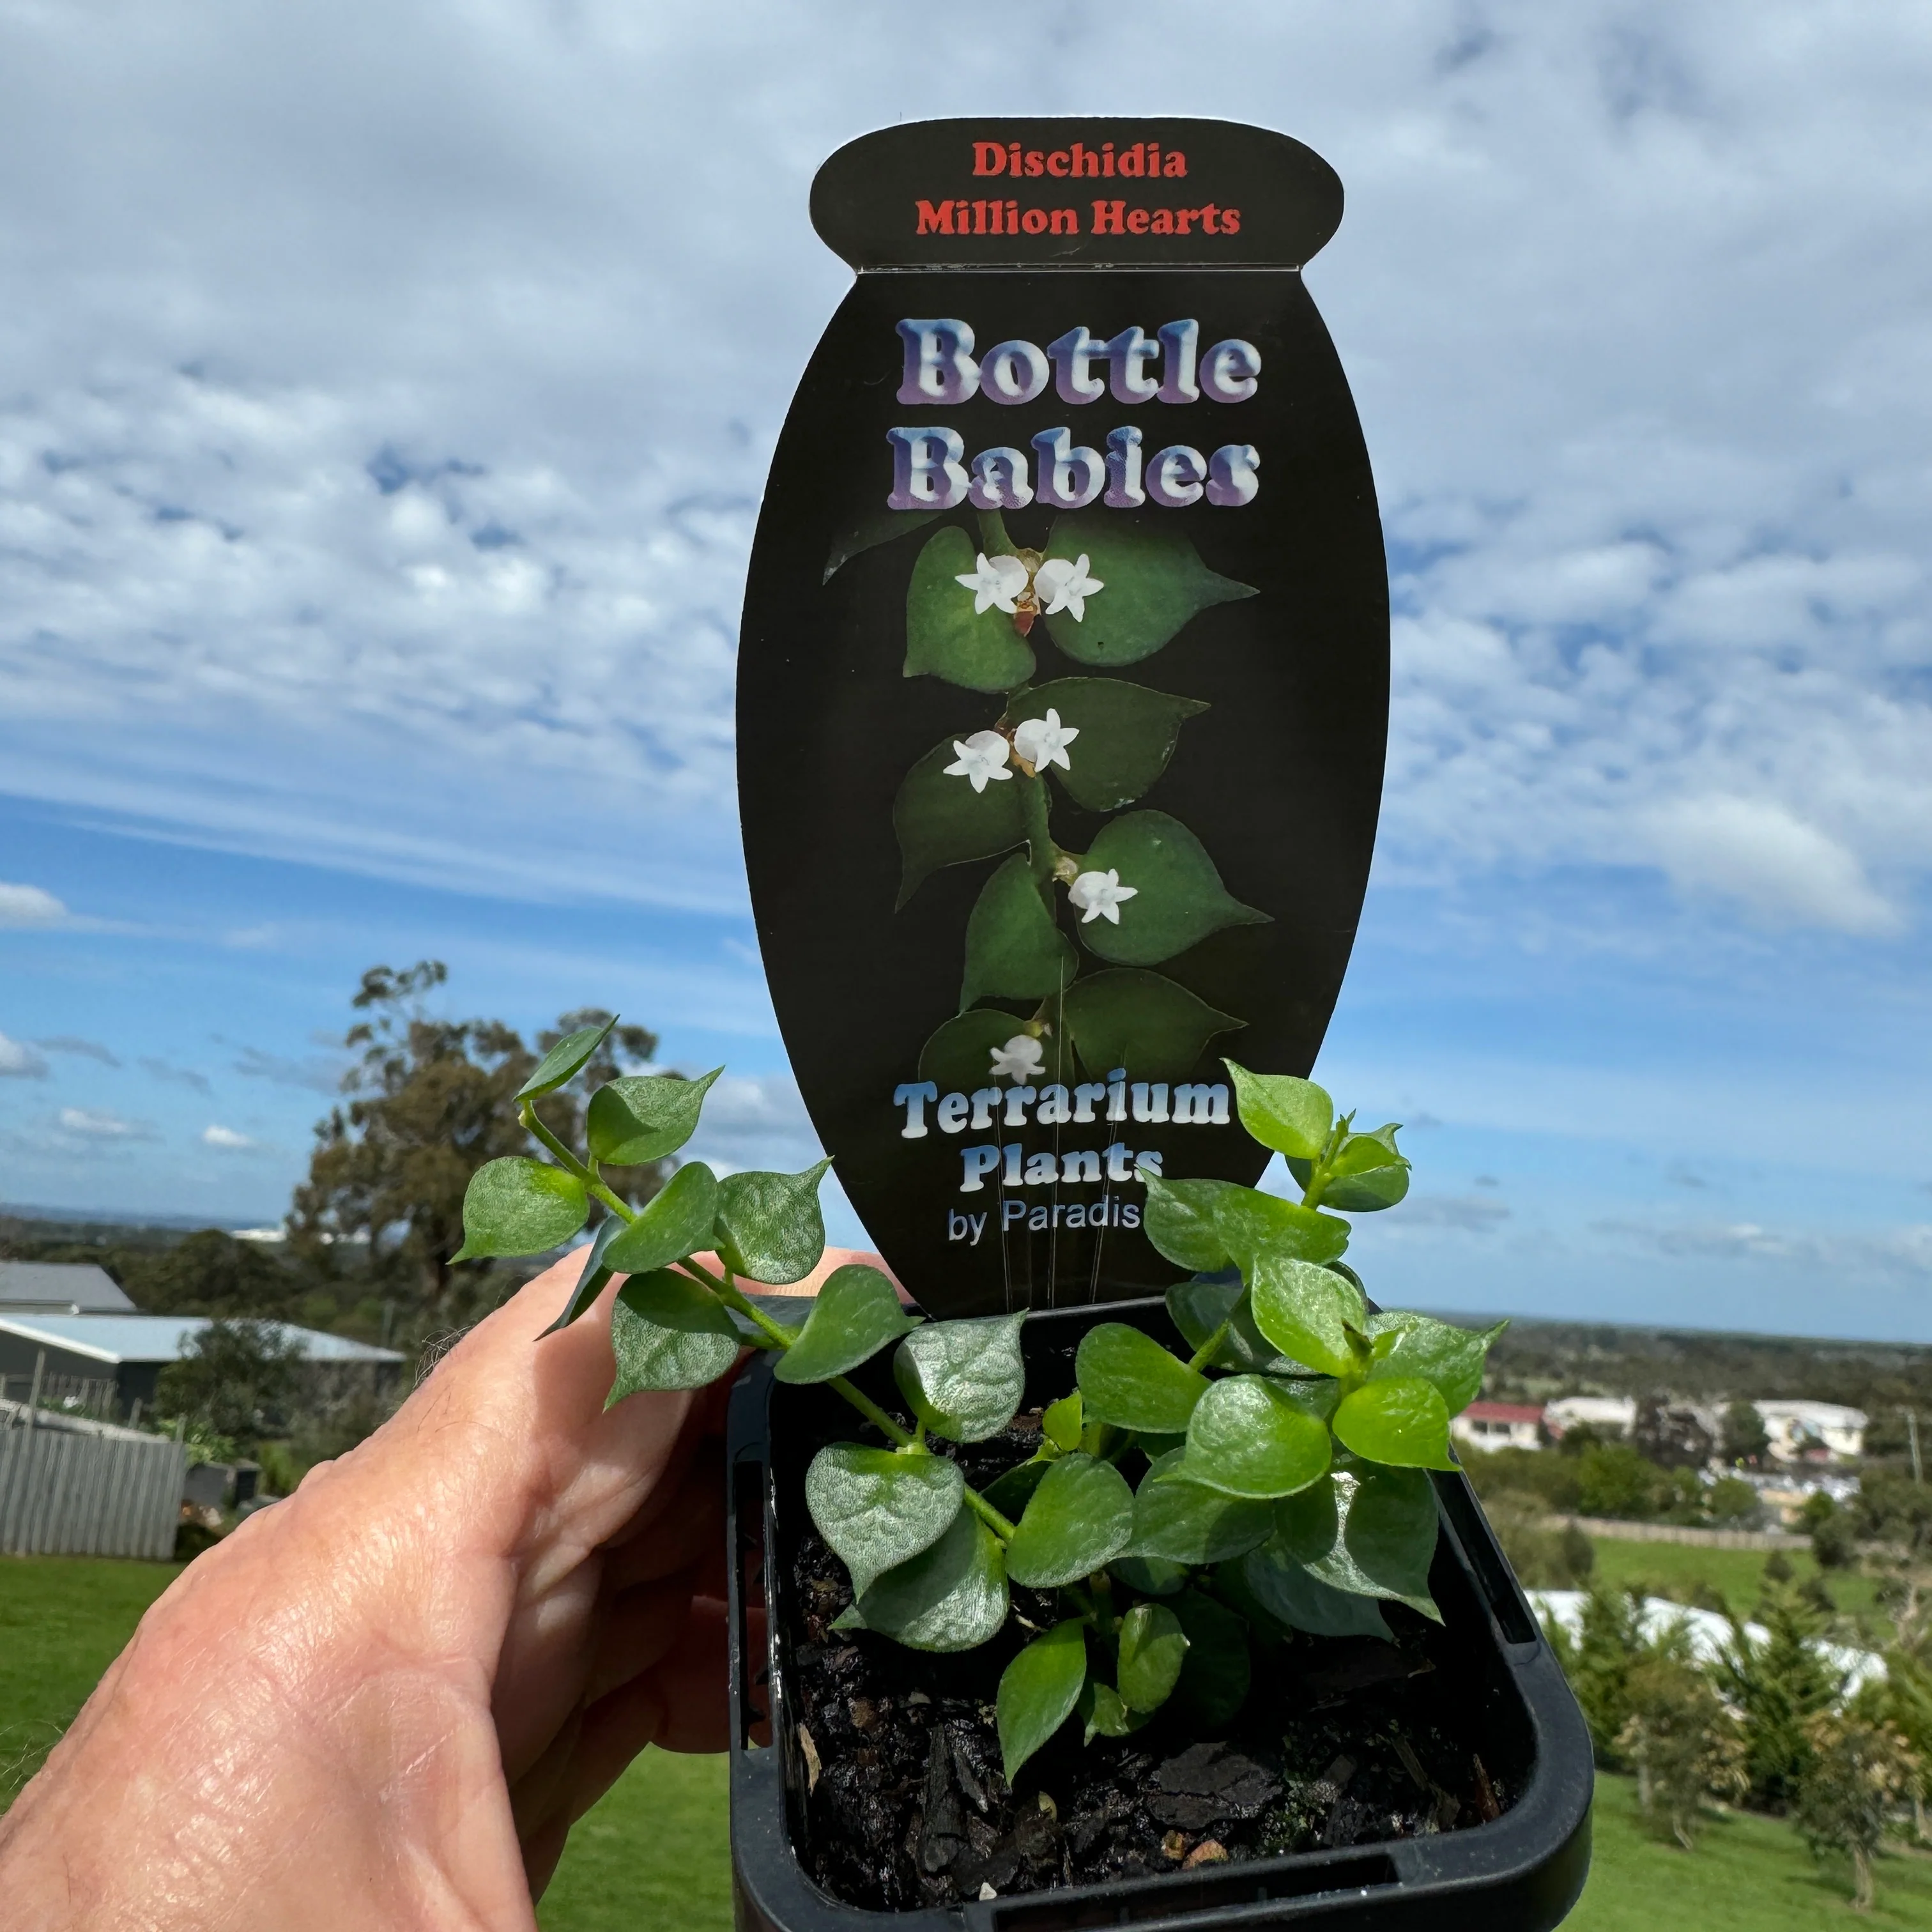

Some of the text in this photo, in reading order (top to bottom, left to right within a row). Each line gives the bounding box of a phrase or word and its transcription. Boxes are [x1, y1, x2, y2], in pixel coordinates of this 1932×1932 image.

[972, 142, 1187, 177] Dischidia
[916, 200, 1241, 235] Million Hearts
[896, 319, 1262, 405] Bottle
[886, 425, 1261, 510] Babies
[894, 1068, 1230, 1139] Terrarium
[959, 1142, 1163, 1193] Plants
[948, 1208, 987, 1246] by
